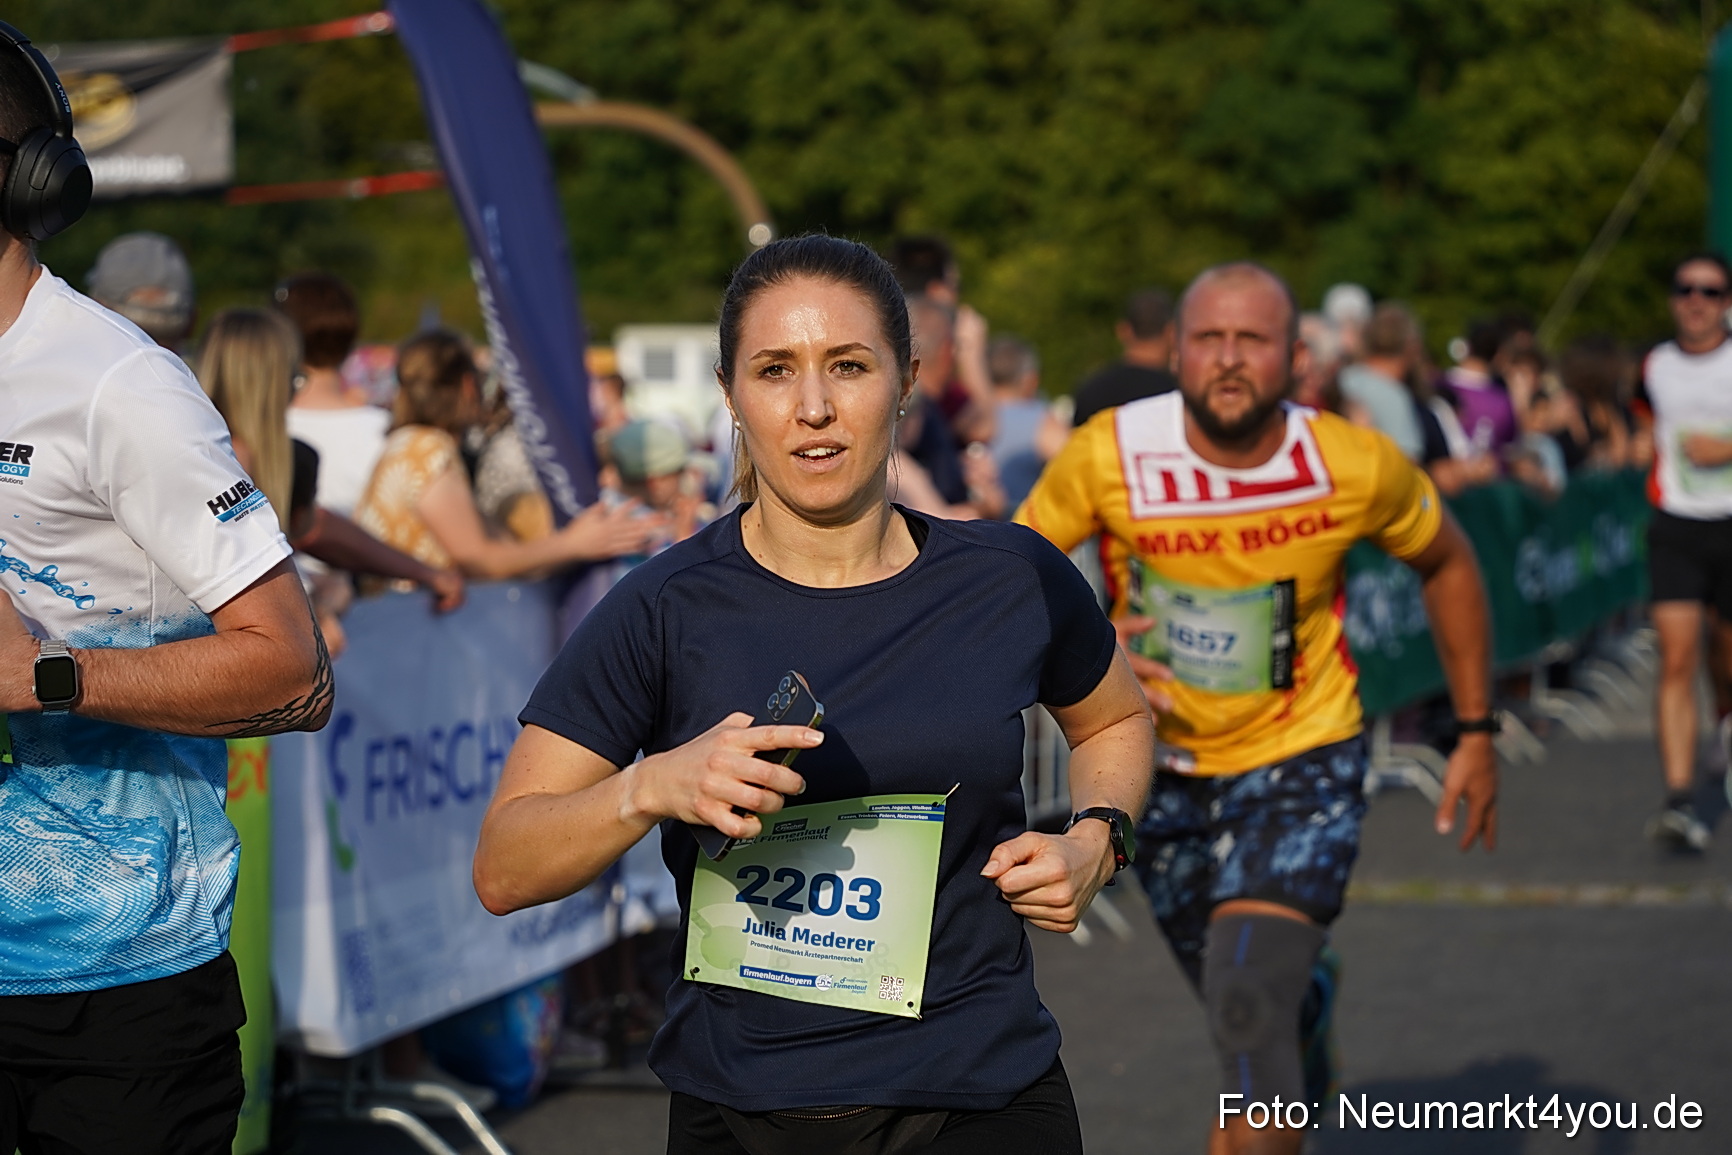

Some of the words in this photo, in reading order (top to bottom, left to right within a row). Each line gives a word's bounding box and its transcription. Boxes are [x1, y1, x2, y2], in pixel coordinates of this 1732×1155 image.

[54, 82, 71, 113] SONY
[0, 464, 26, 475] OGY
[1136, 530, 1222, 555] MAX
[1239, 509, 1342, 552] BÖGL
[364, 709, 519, 826] FRISCH
[760, 826, 831, 843] Firmenlauf
[786, 834, 828, 843] neumarkt
[735, 865, 882, 921] 2203
[741, 917, 787, 941] Julia
[791, 926, 876, 952] Mederer
[750, 940, 774, 951] Promed
[774, 945, 804, 957] Neumarkt
[804, 950, 864, 964] Ärztepartnerschaft
[743, 968, 813, 986] firmenlauf.bayern
[833, 982, 868, 991] Firmenlauf
